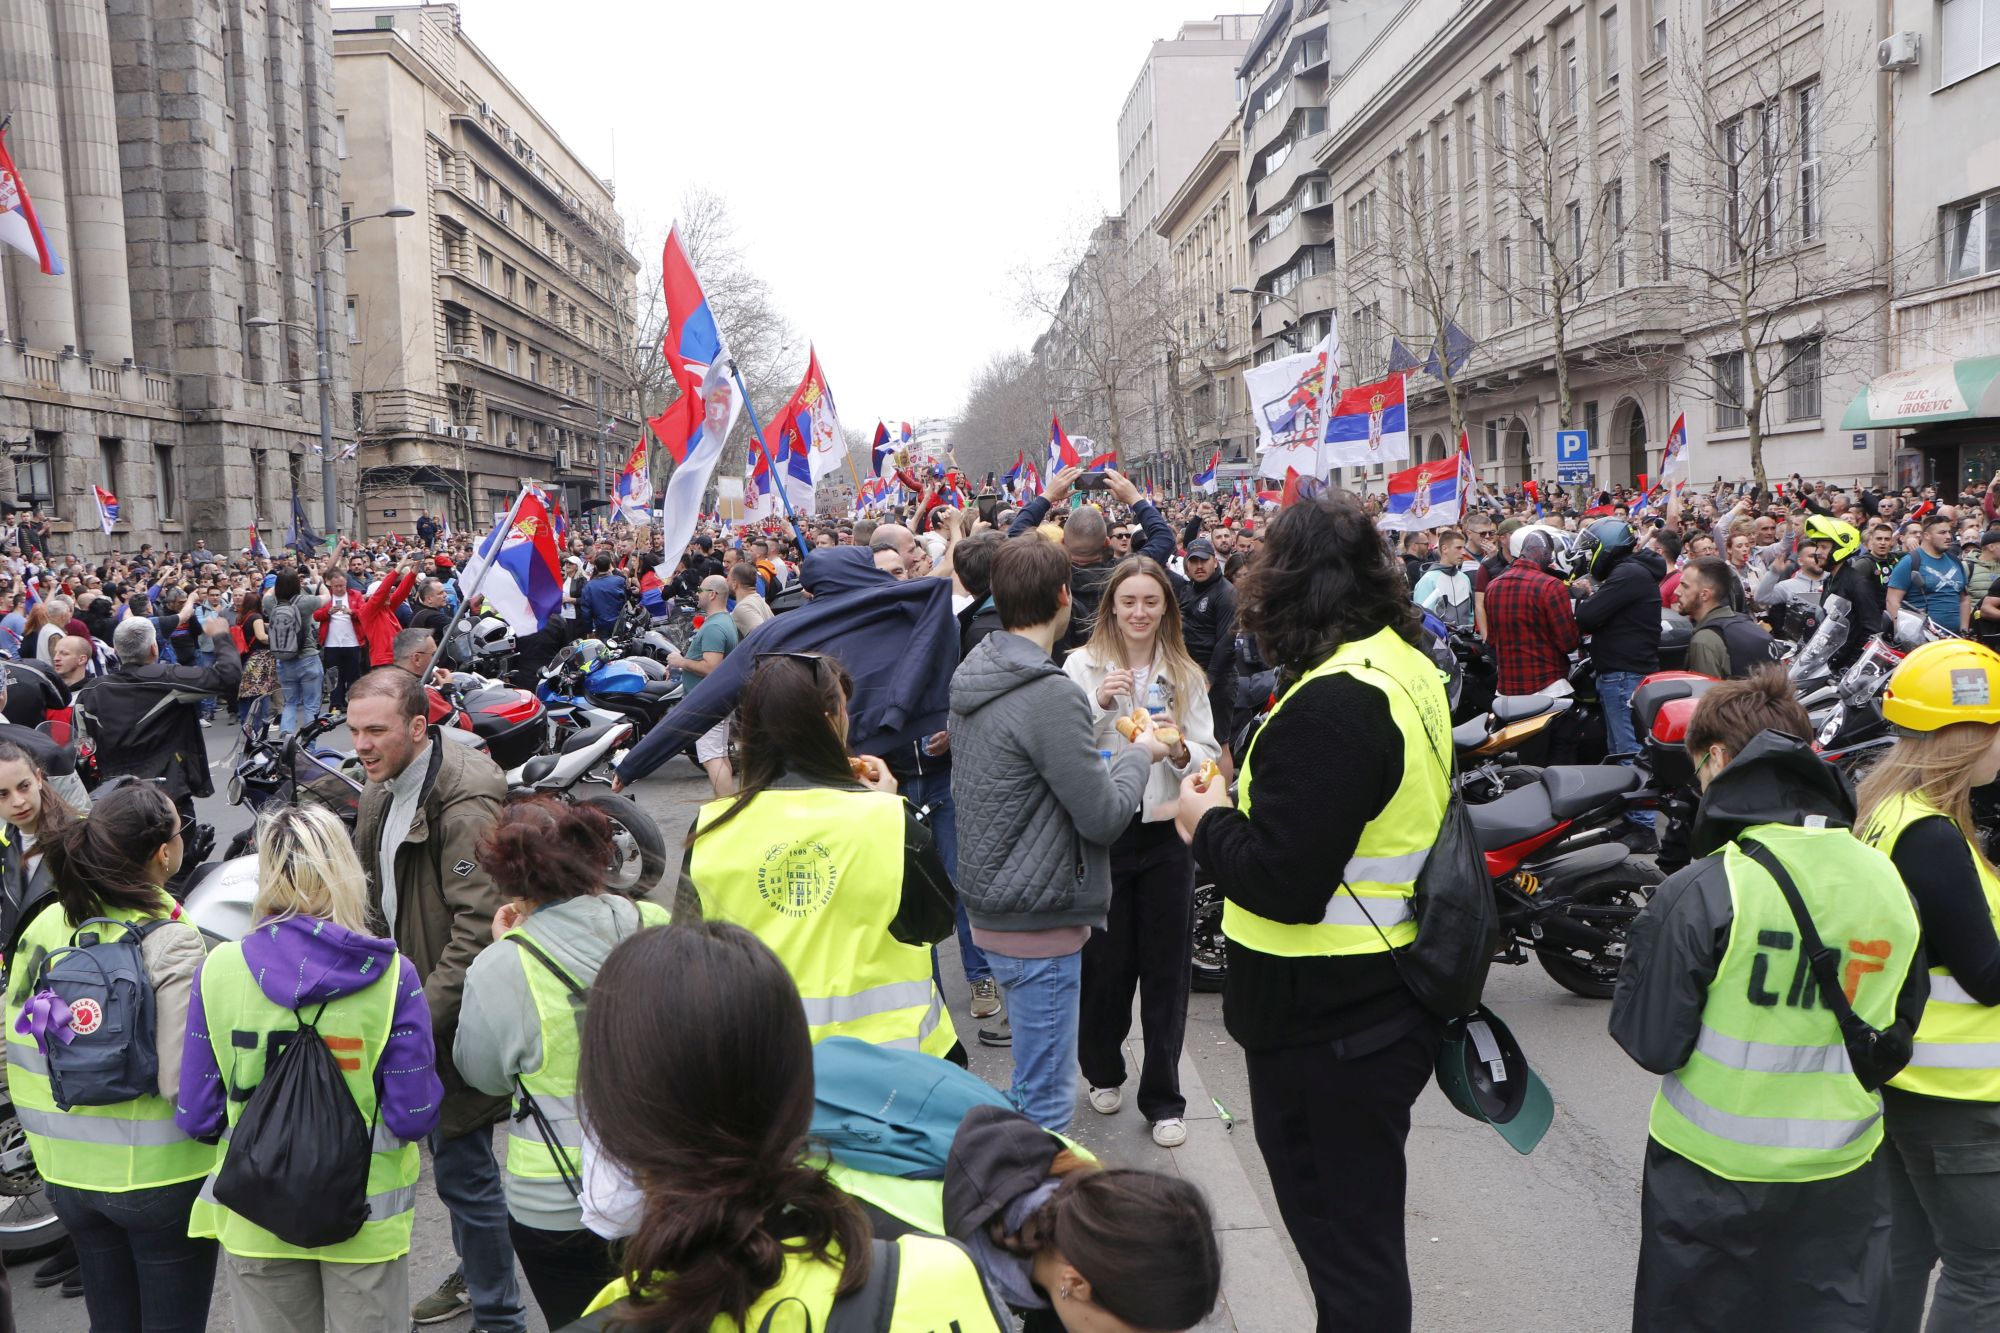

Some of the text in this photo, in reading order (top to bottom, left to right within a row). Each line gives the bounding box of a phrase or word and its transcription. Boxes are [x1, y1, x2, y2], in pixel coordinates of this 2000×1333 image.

[1903, 389, 1928, 401] BLIC
[1563, 435, 1581, 458] P
[789, 848, 807, 857] 1808
